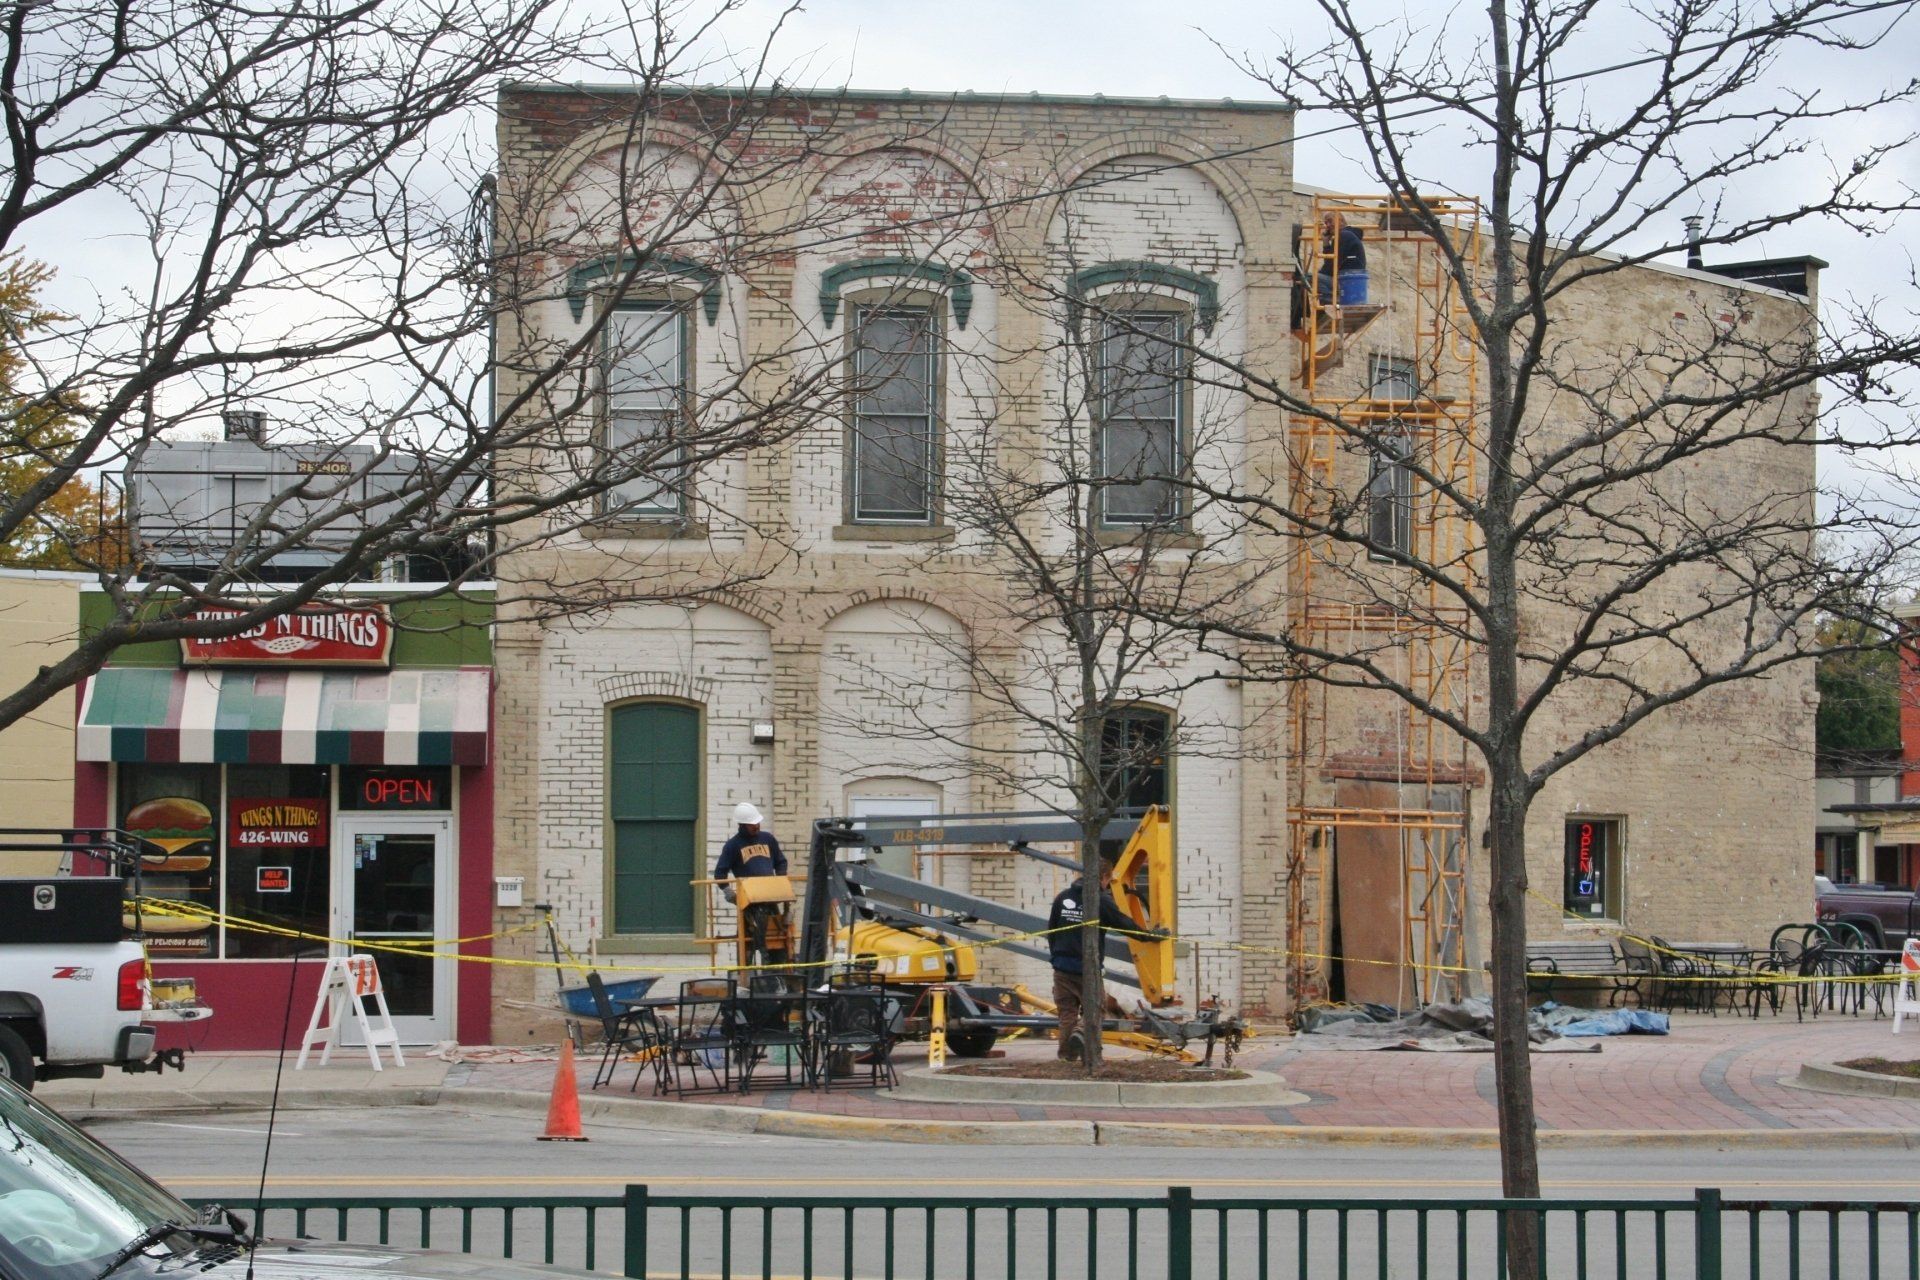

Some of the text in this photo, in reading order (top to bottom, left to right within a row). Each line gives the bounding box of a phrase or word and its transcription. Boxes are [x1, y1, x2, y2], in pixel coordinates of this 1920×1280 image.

[297, 612, 379, 647] THINGS
[365, 778, 434, 803] OPEN
[241, 807, 273, 826] WINGS
[274, 806, 282, 826] N
[239, 831, 309, 843] 426-WING
[1579, 823, 1593, 874] OPEN
[260, 879, 289, 888] WANTED
[264, 871, 283, 879] HELP
